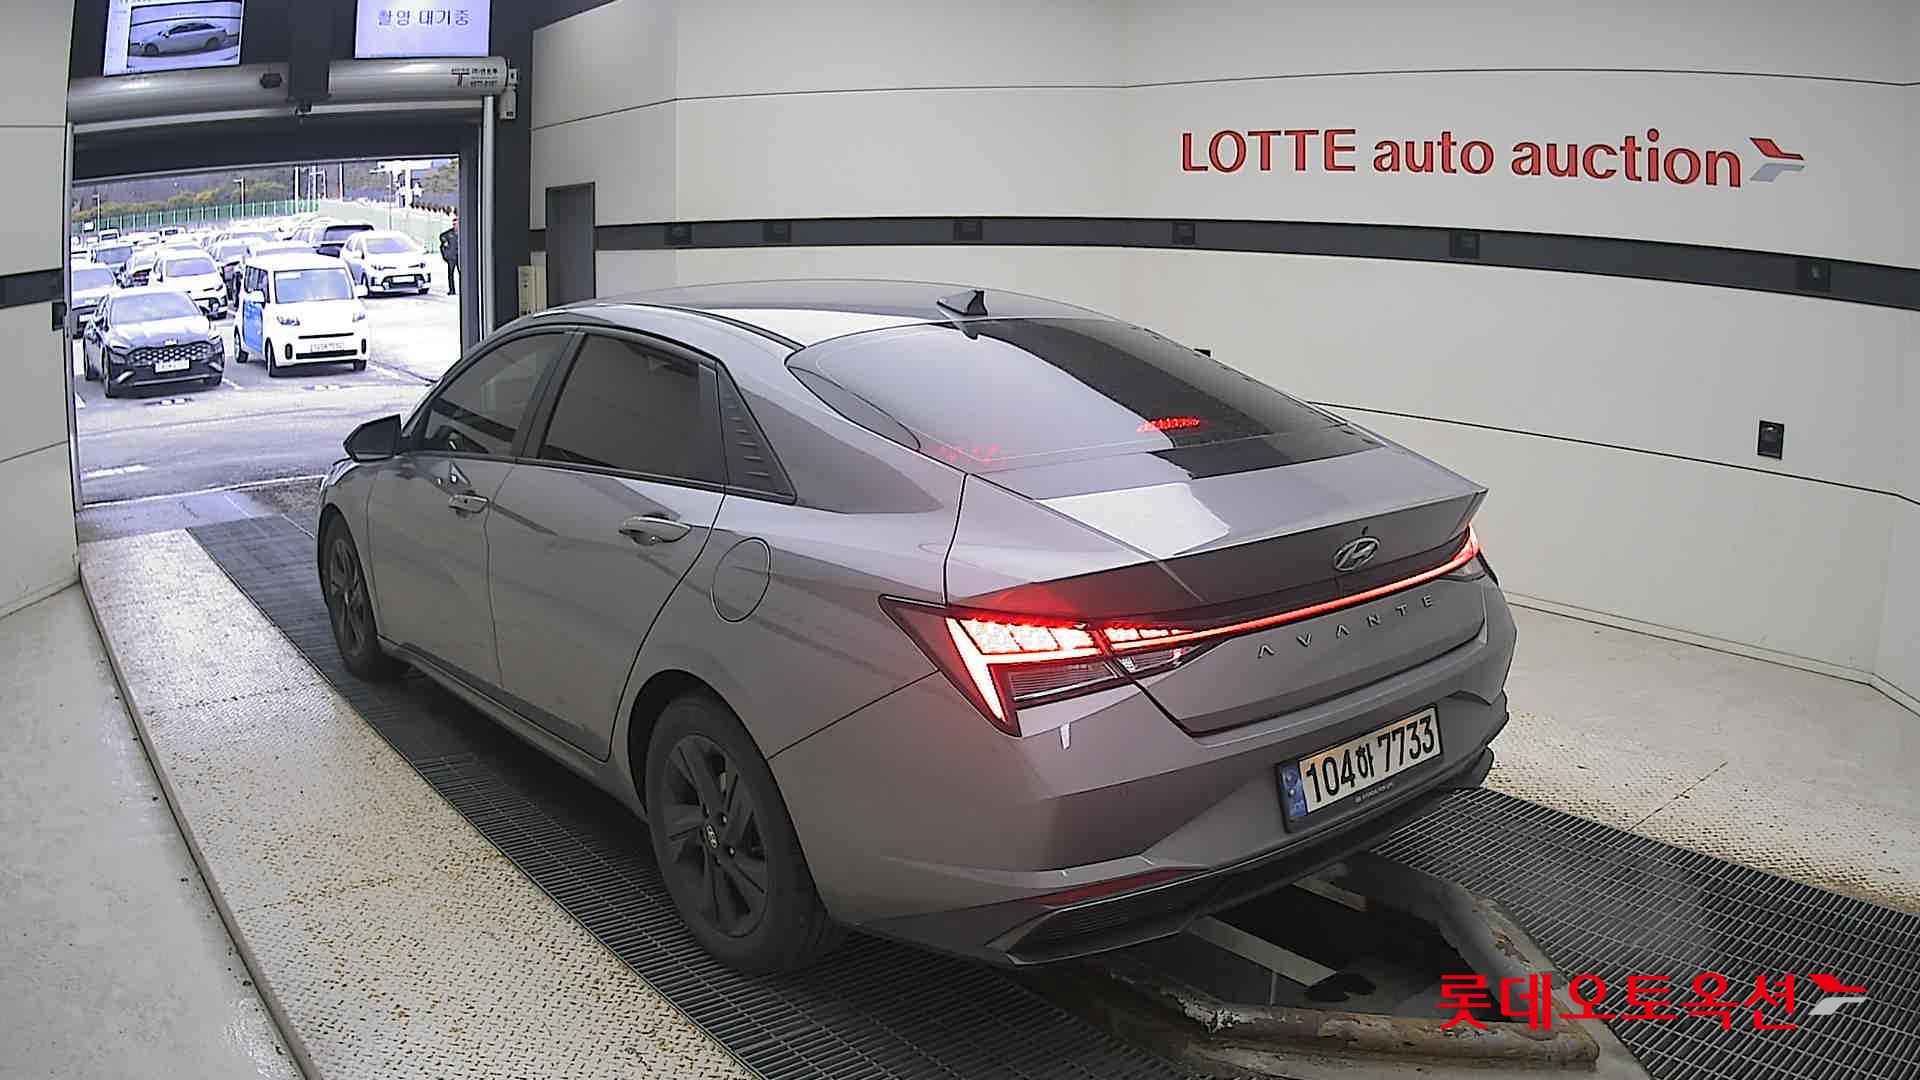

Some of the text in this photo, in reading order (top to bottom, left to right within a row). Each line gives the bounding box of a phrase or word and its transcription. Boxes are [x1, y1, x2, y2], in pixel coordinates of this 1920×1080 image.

[1182, 128, 1742, 188] LOTTE auto auction
[1257, 593, 1434, 660] AVANTE
[1306, 714, 1436, 803] 104하 7733
